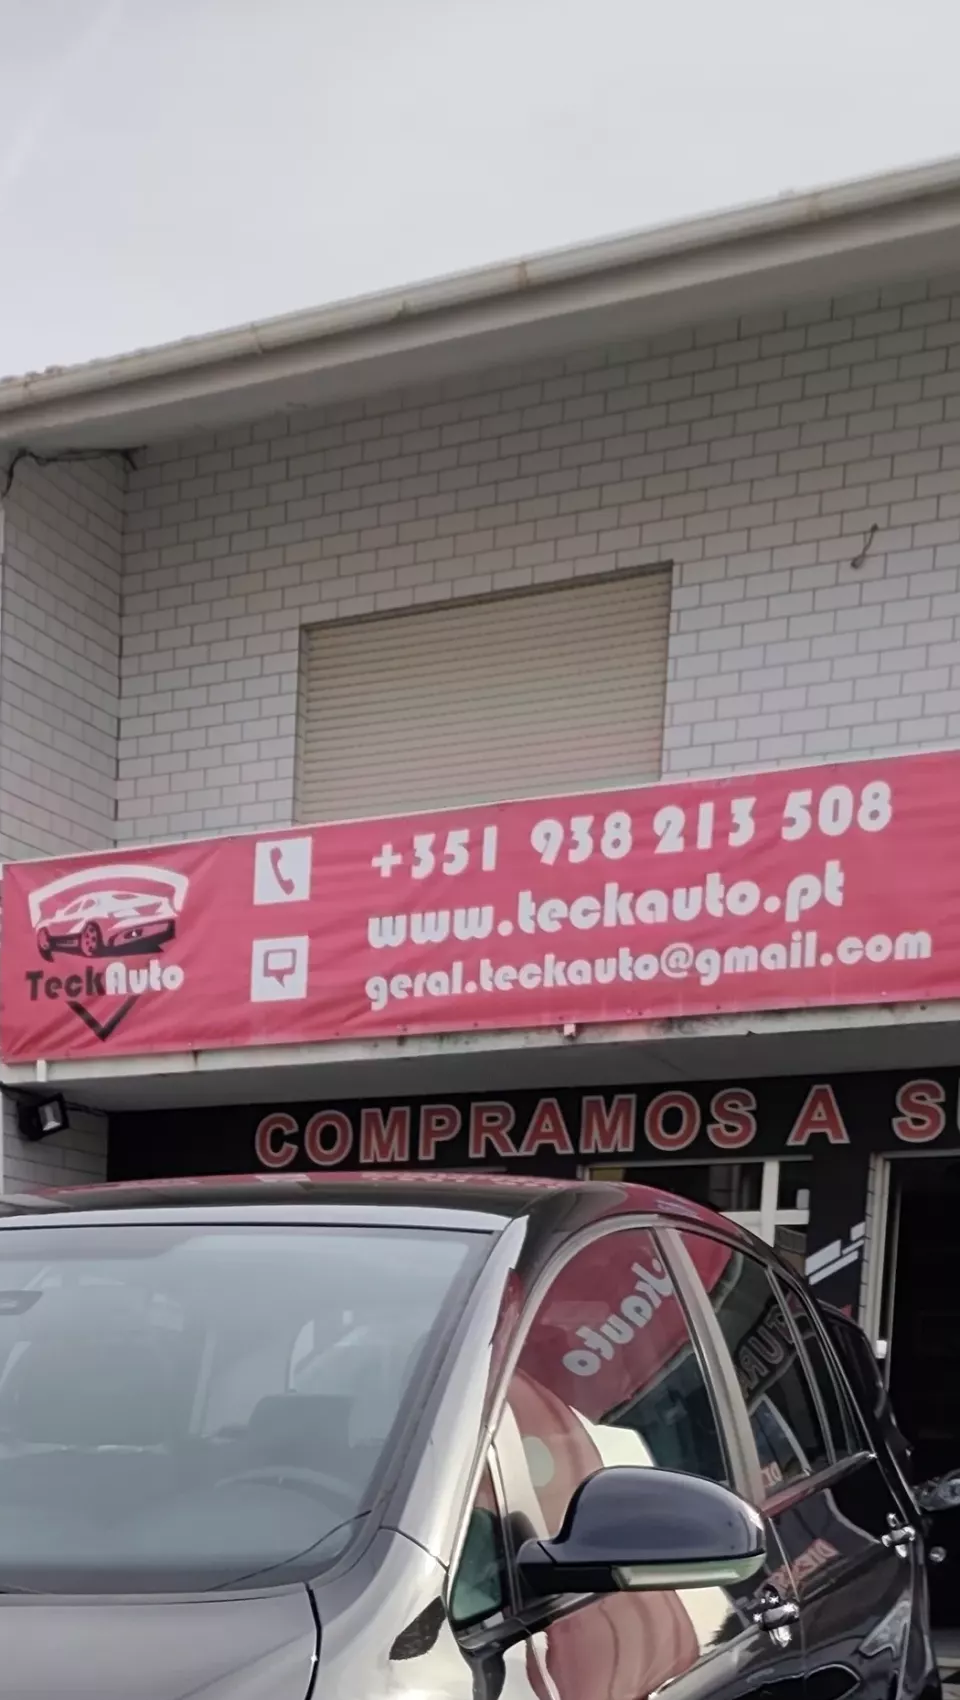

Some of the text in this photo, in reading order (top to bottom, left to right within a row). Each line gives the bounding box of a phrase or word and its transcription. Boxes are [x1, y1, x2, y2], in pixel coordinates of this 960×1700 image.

[371, 781, 893, 880] +351 938 213 508
[367, 860, 845, 949] www.teckauto.pt
[25, 957, 185, 1001] TeckAuto
[365, 929, 933, 1011] geral.teckauto@gmail.com
[255, 1077, 960, 1168] COMPRAMOS A S
